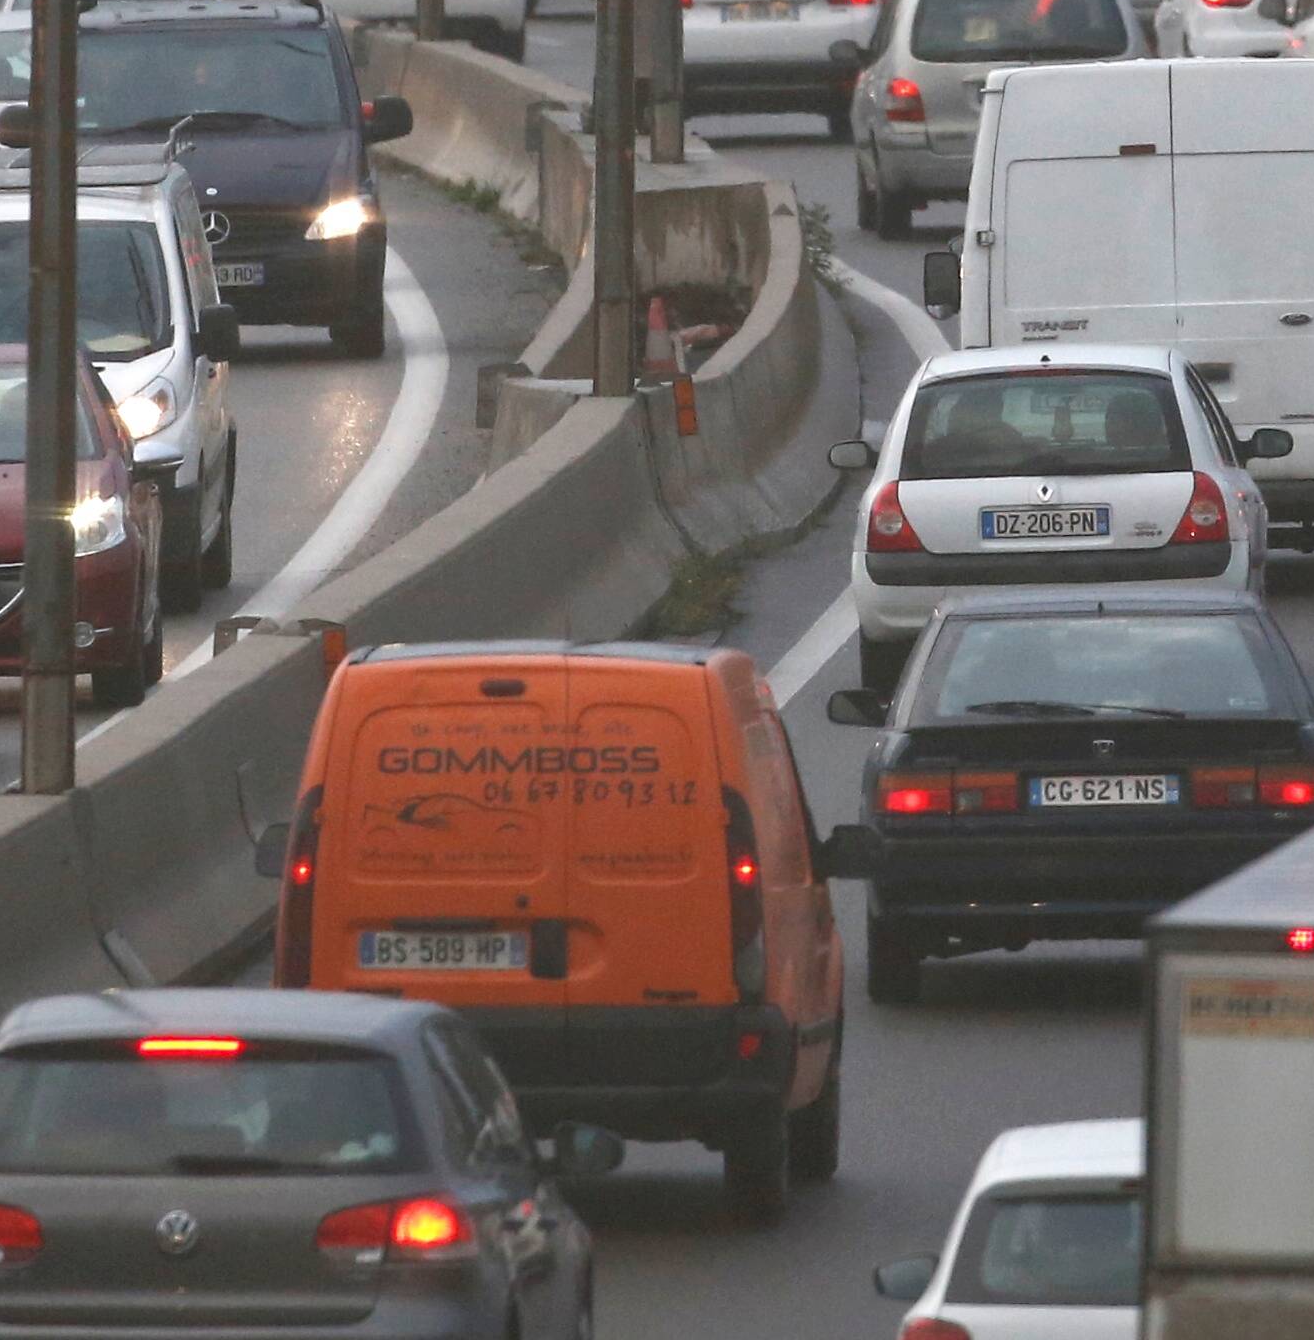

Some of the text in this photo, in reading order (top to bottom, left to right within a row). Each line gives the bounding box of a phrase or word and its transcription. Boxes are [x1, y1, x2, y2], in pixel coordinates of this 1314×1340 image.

[996, 511, 1095, 535] DZ-206-PN
[378, 746, 660, 774] GOMMBOSS
[1044, 778, 1165, 802] CG-621-NS
